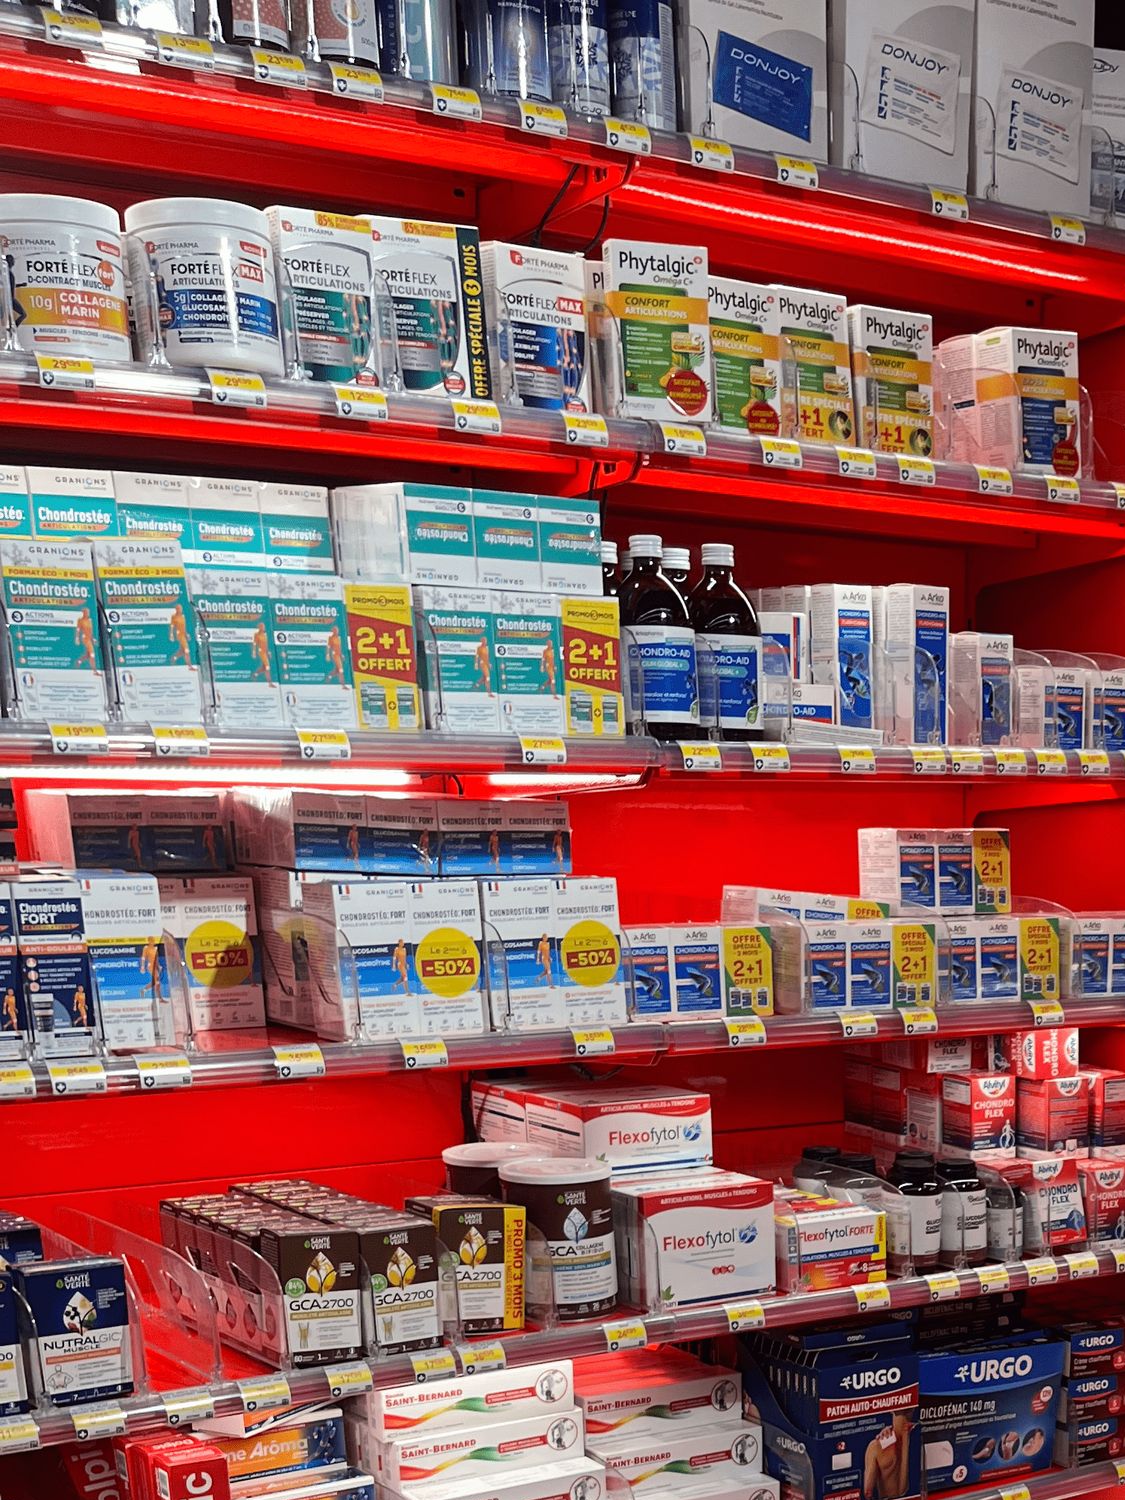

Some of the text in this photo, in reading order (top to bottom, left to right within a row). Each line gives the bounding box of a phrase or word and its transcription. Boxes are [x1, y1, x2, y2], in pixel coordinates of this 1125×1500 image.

[731, 47, 801, 84] DONJOY
[881, 43, 945, 75] DONJOY
[1010, 78, 1071, 108] DONJOY
[25, 259, 98, 278] FORTÉ FLEX
[465, 244, 478, 277] MOIS
[618, 251, 696, 277] Phytalgic
[708, 285, 769, 312] Phytalgic
[60, 305, 100, 320] MARIN
[779, 296, 840, 324] Phytalgic
[468, 301, 486, 358] SPÉCIALE
[866, 316, 925, 341] Phytalgic
[474, 362, 489, 397] OFFRE
[357, 625, 408, 656] 2+1
[569, 637, 617, 666] 2+1
[358, 654, 411, 672] OFFERT
[570, 666, 617, 681] OFFERT
[20, 912, 57, 925] FORT
[423, 958, 472, 976] -50%
[567, 949, 616, 968] -50%
[733, 960, 763, 977] 2+1
[901, 956, 927, 973] 2+1
[609, 1125, 681, 1146] Flexofytol
[513, 1219, 522, 1269] PROMO
[663, 1229, 736, 1251] Flexofytol
[289, 1298, 353, 1311] GCA2700
[374, 1290, 435, 1306] GCA2700
[513, 1285, 522, 1318] MOIS
[43, 1332, 120, 1352] NUTRALGIC
[853, 1369, 901, 1389] URGO
[970, 1357, 1032, 1381] URGO
[385, 1388, 463, 1408] SAINT-BERNARD
[826, 1395, 912, 1417] PATCH AUTO-CHAUFFANT
